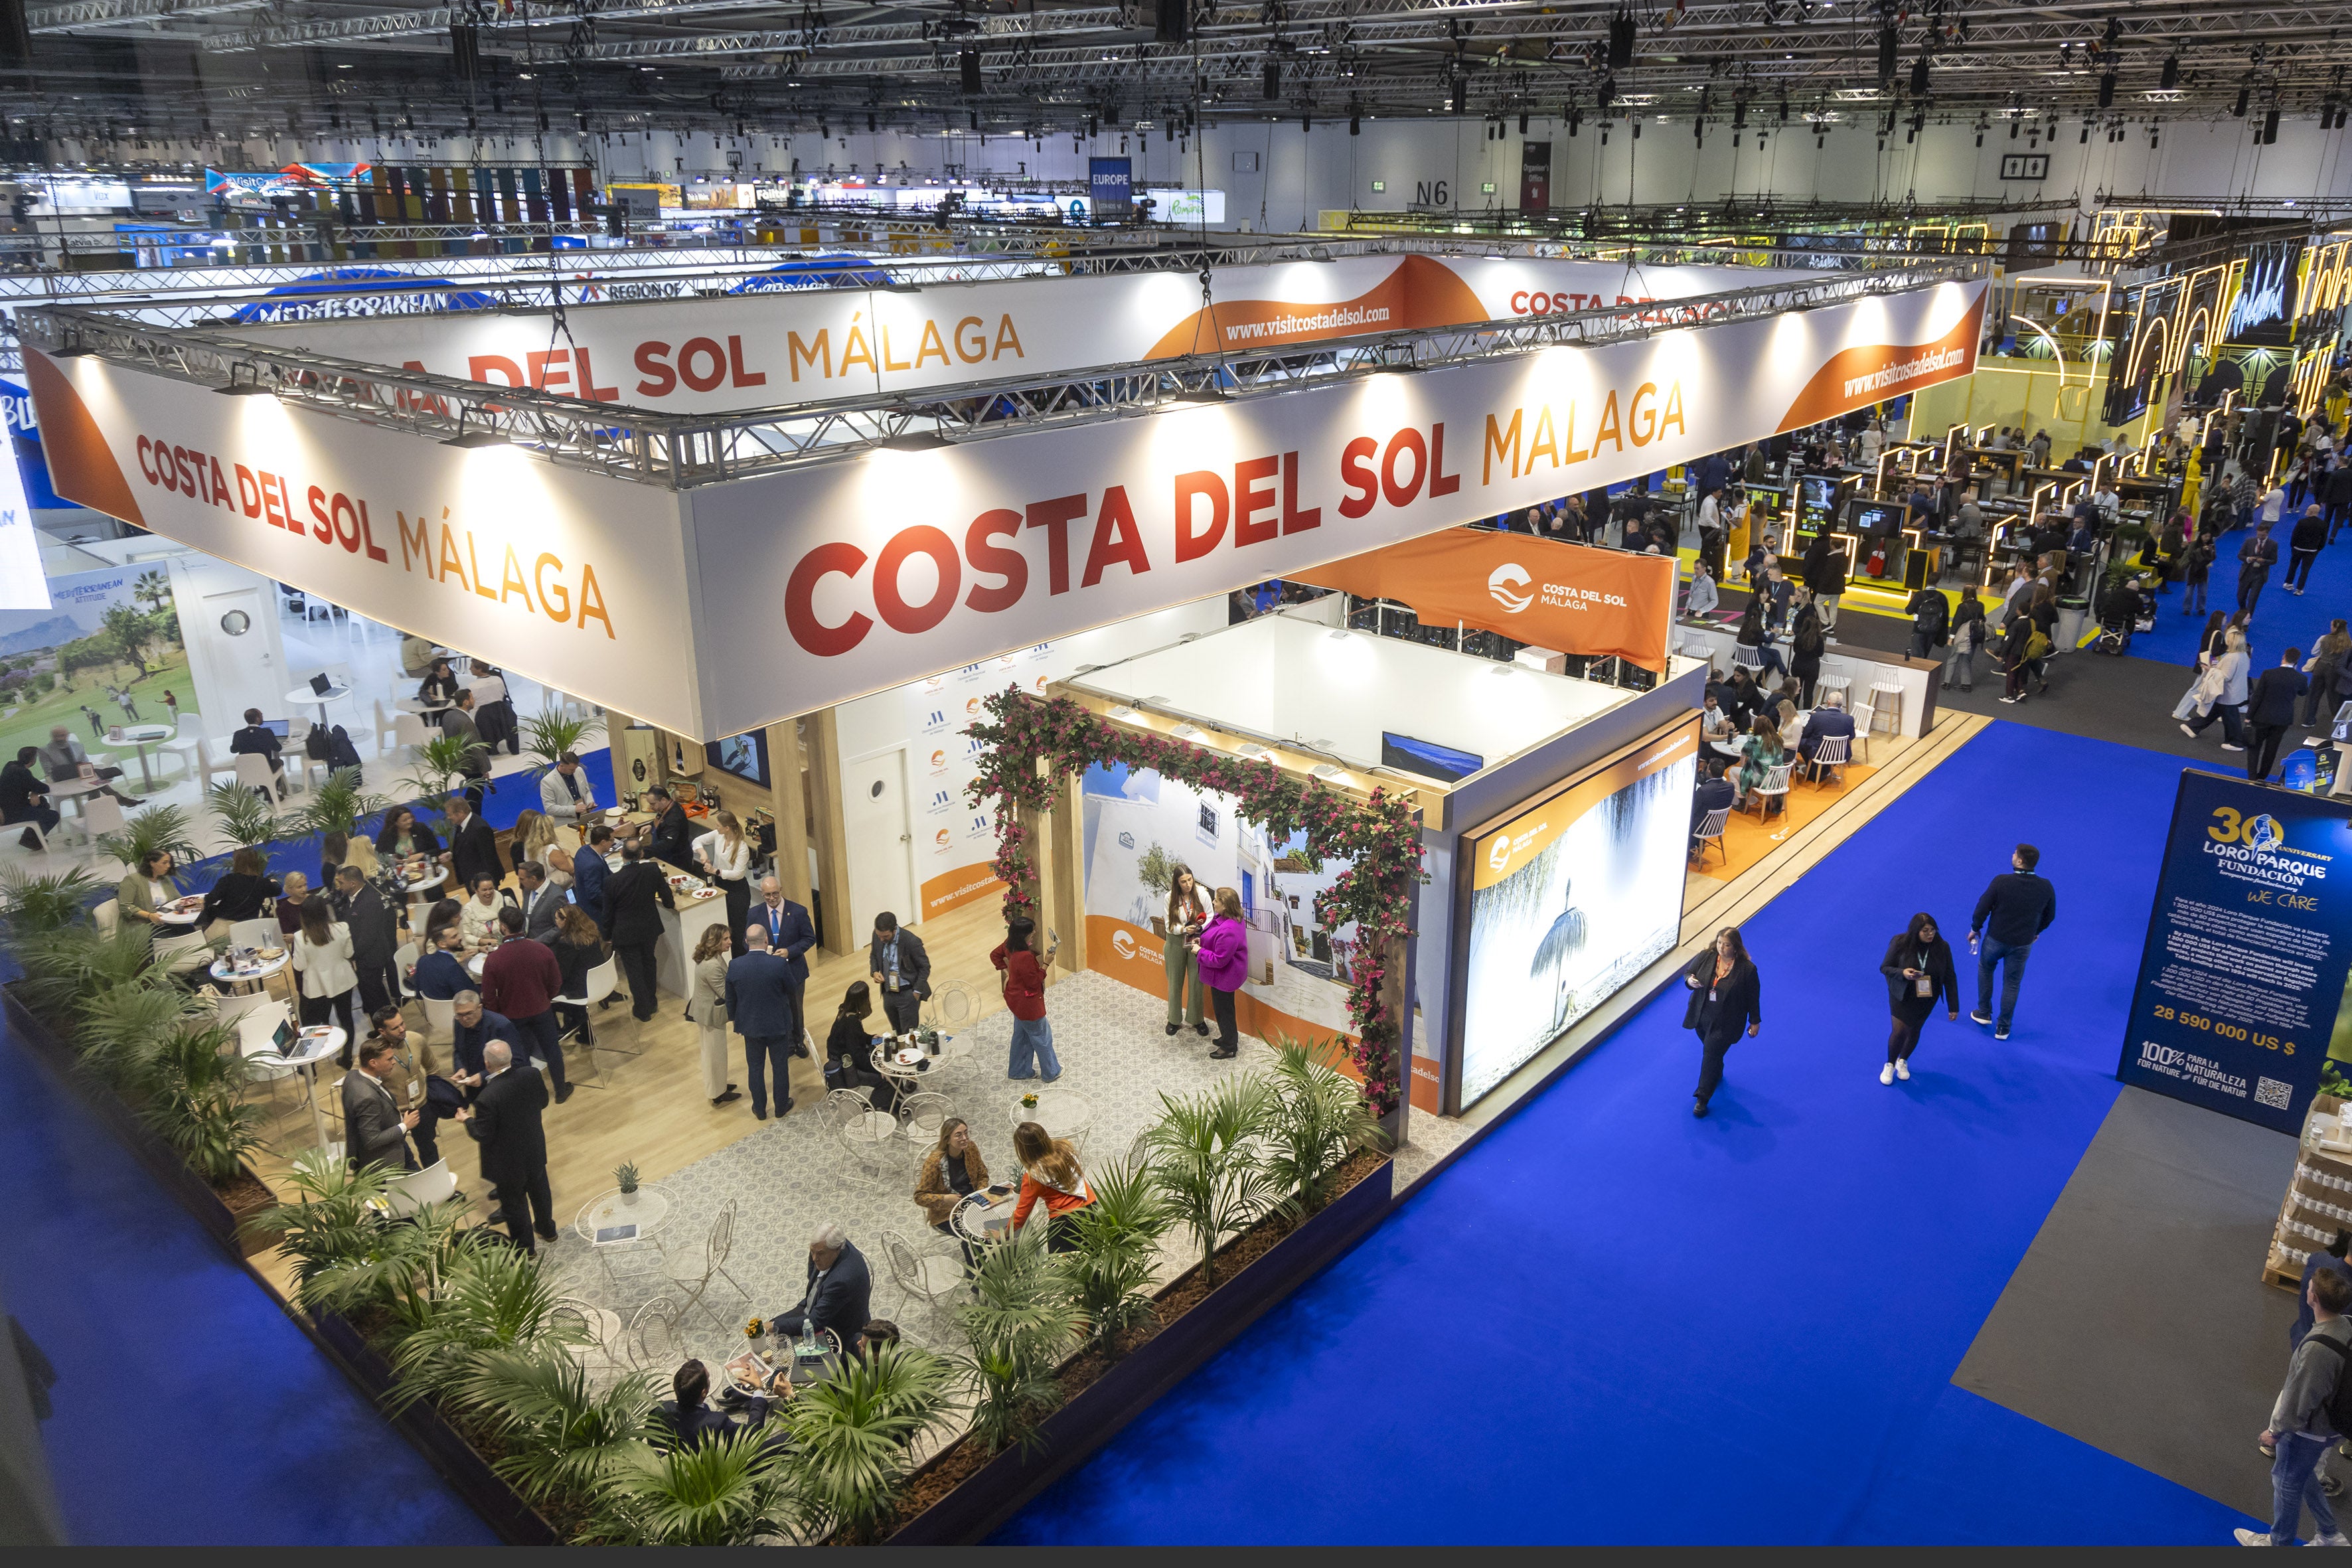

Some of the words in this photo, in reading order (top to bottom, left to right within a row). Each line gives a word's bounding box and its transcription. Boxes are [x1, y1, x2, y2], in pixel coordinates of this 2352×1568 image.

[1093, 173, 1129, 185] EUROPE
[1523, 163, 1549, 173] Organiser's
[1528, 174, 1543, 183] Office
[1417, 180, 1449, 205] N6
[1226, 305, 1390, 341] www.visitcostadelsol.com
[635, 335, 766, 398] SOL
[787, 311, 1025, 382] MÁLAGA
[1844, 347, 1965, 399] www.visitcostadelsol.com
[136, 434, 236, 512] COSTA
[234, 462, 307, 536] DEL
[307, 485, 388, 564] SOL
[396, 505, 616, 641] MÁLAGA
[785, 485, 1150, 657] COSTA
[1174, 451, 1321, 565] DEL
[1336, 422, 1460, 519] SOL
[1541, 594, 1588, 611] MÁLAGA
[1542, 583, 1579, 598] COSTA
[1580, 589, 1602, 603] DEL
[1604, 593, 1628, 607] SOL
[2207, 806, 2284, 852] 30
[2203, 840, 2250, 862] LORO
[2256, 853, 2327, 879] PARQUE
[2276, 844, 2333, 862] ANNIVERSARY
[2217, 856, 2306, 887] FUNDACIÓN
[2247, 889, 2273, 906] WE
[2277, 893, 2319, 911] CARE
[1138, 945, 1158, 959] COSTA
[1138, 951, 1163, 967] MÁLAGA
[2153, 1004, 2175, 1020] 28
[2179, 1012, 2211, 1031] 590
[2215, 1022, 2248, 1042] 000
[2252, 1032, 2280, 1051] US
[2283, 1042, 2296, 1056] $
[2142, 1040, 2185, 1067] 100%
[2187, 1054, 2207, 1067] PARA
[2208, 1059, 2219, 1070] LA
[2136, 1058, 2152, 1069] FOR
[2152, 1062, 2180, 1078] NATURE
[2185, 1061, 2246, 1089] NATURALEZA
[2192, 1074, 2207, 1086] FÜR
[2208, 1079, 2221, 1090] DIE
[2221, 1083, 2246, 1099] NATUR
